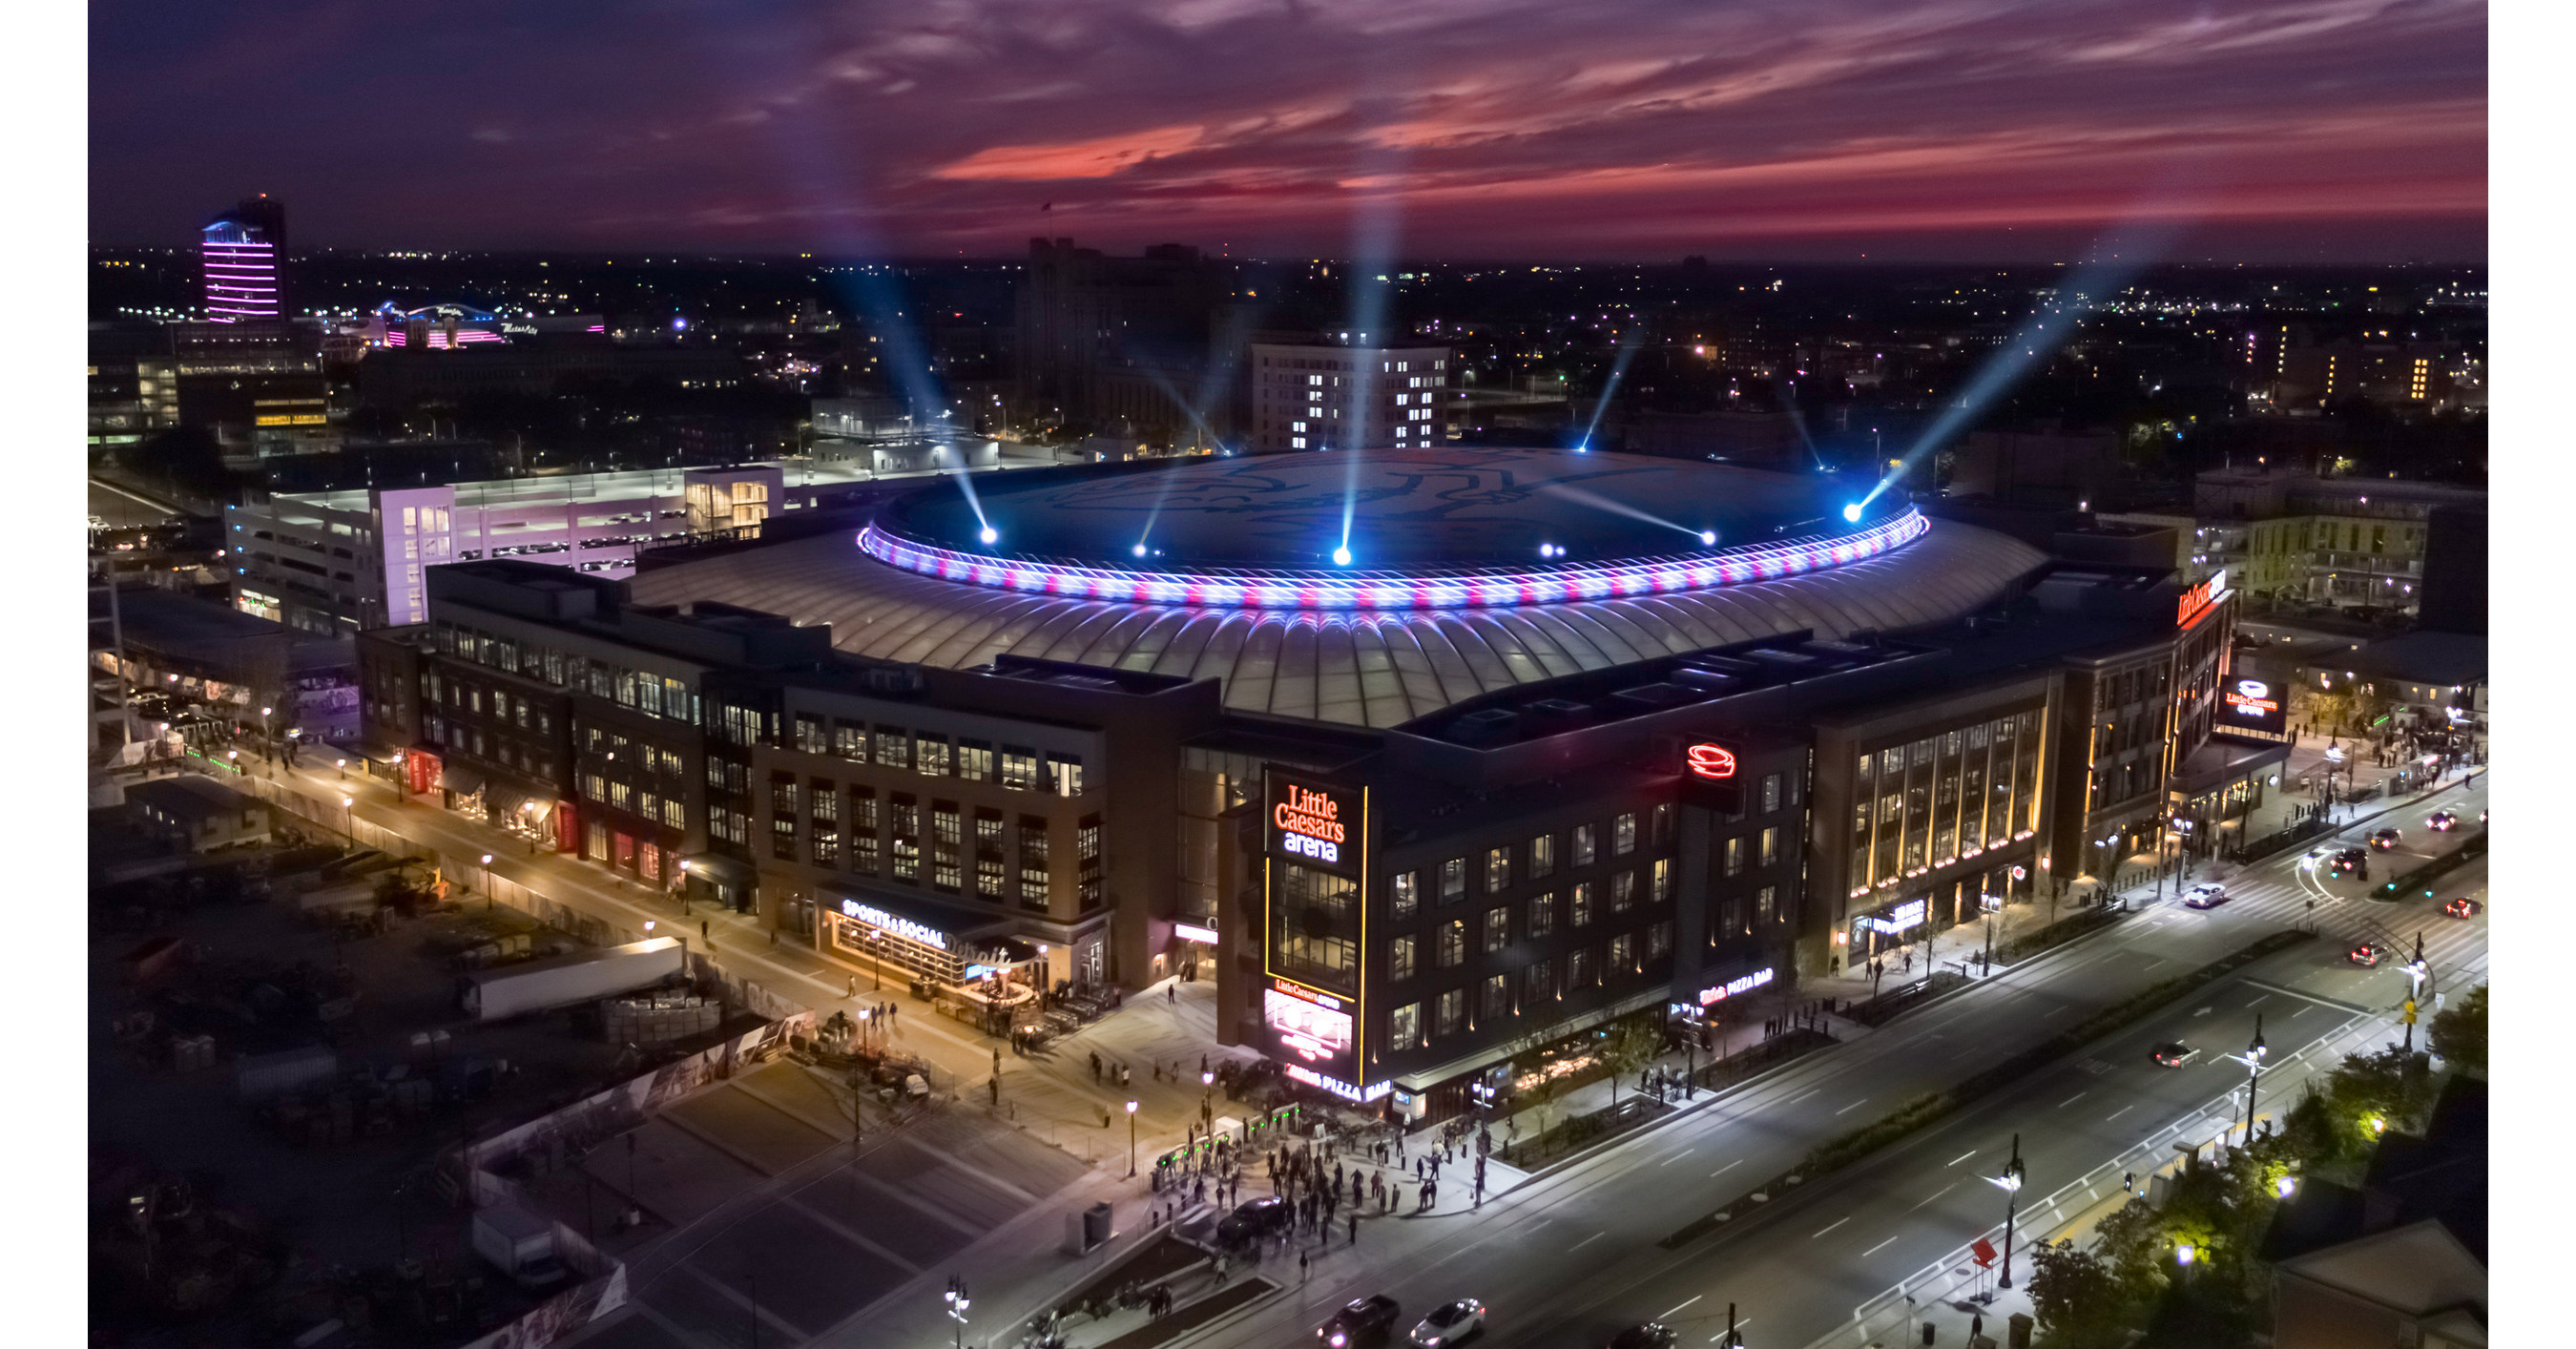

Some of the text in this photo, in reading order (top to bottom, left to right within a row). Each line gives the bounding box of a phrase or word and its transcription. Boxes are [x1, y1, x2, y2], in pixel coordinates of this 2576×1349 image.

[1288, 784, 1338, 820] Little
[1274, 802, 1345, 844] Caesars
[1283, 831, 1338, 862] arena
[842, 899, 891, 929] SPORTS
[898, 918, 946, 950] SOCIAL
[945, 931, 1012, 965] Detroit
[1275, 978, 1294, 995] Little
[1293, 984, 1319, 1003] Caesars
[1726, 975, 1754, 997] PIZZA
[1753, 966, 1774, 987] BAR
[1321, 1074, 1362, 1103] PIZZA
